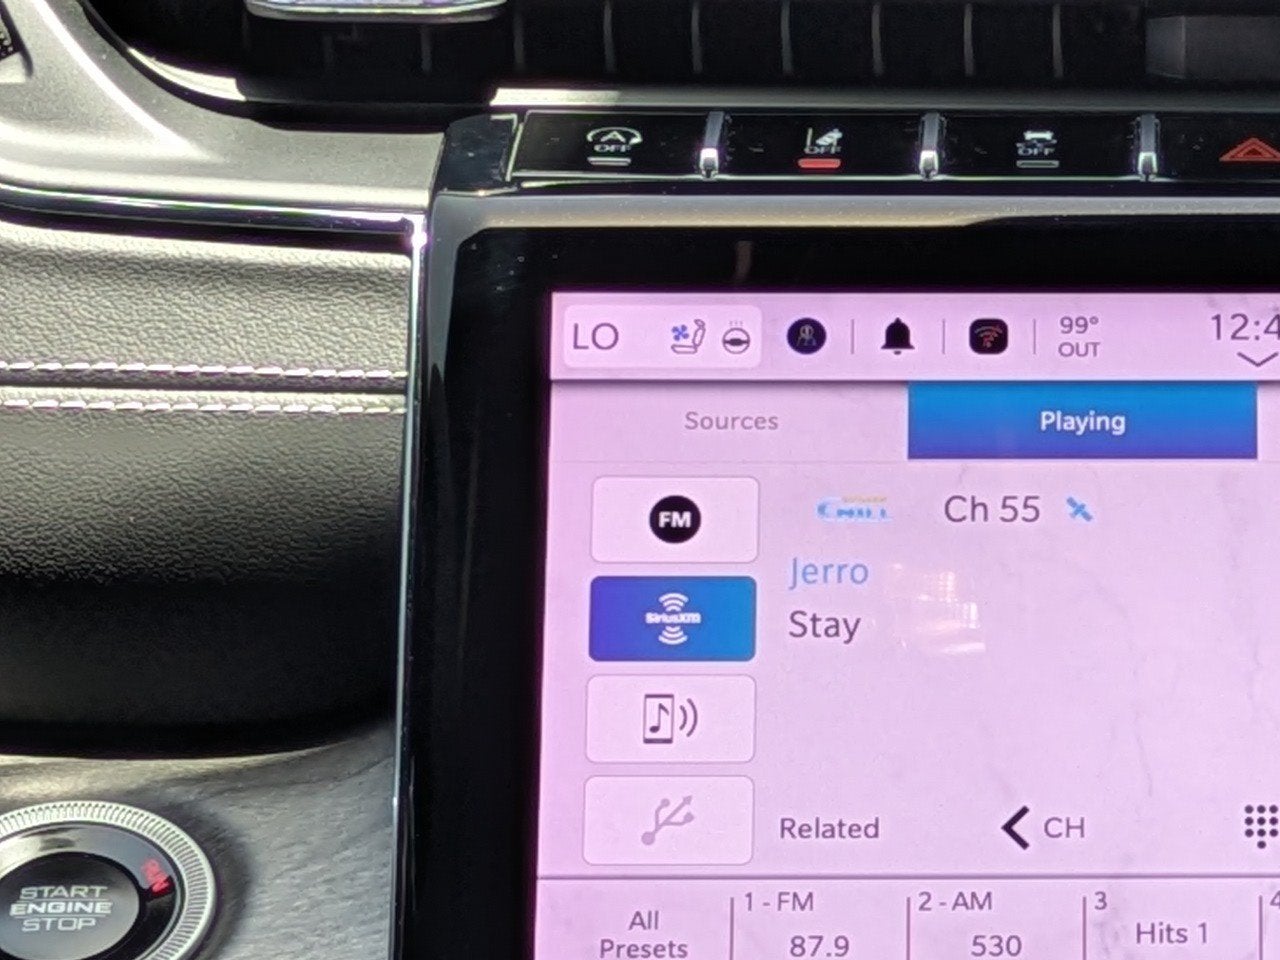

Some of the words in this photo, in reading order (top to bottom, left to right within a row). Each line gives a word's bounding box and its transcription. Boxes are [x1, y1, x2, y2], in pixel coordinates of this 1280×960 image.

[1059, 316, 1099, 335] 99°
[572, 323, 619, 350] LO
[1058, 341, 1101, 358] OUT
[684, 411, 779, 432] Sources
[1040, 410, 1126, 435] Playing
[943, 494, 990, 523] Ch
[999, 496, 1041, 523] 55
[658, 510, 692, 529] FM
[788, 557, 869, 590] Jerro
[788, 609, 861, 644] Stay
[779, 817, 880, 839] Related
[1043, 816, 1086, 838] CH
[19, 885, 108, 900] START
[777, 891, 815, 911] FM
[917, 892, 932, 911] 2
[951, 891, 993, 911] AM
[1093, 891, 1108, 911] 3
[9, 901, 113, 916] ENGINE
[21, 917, 97, 932] STOP
[628, 910, 660, 930] All
[1136, 922, 1189, 944] Hits
[1197, 922, 1208, 944] 1
[599, 938, 688, 960] Presets
[789, 935, 850, 957] 87.9
[970, 934, 1022, 957] 530
